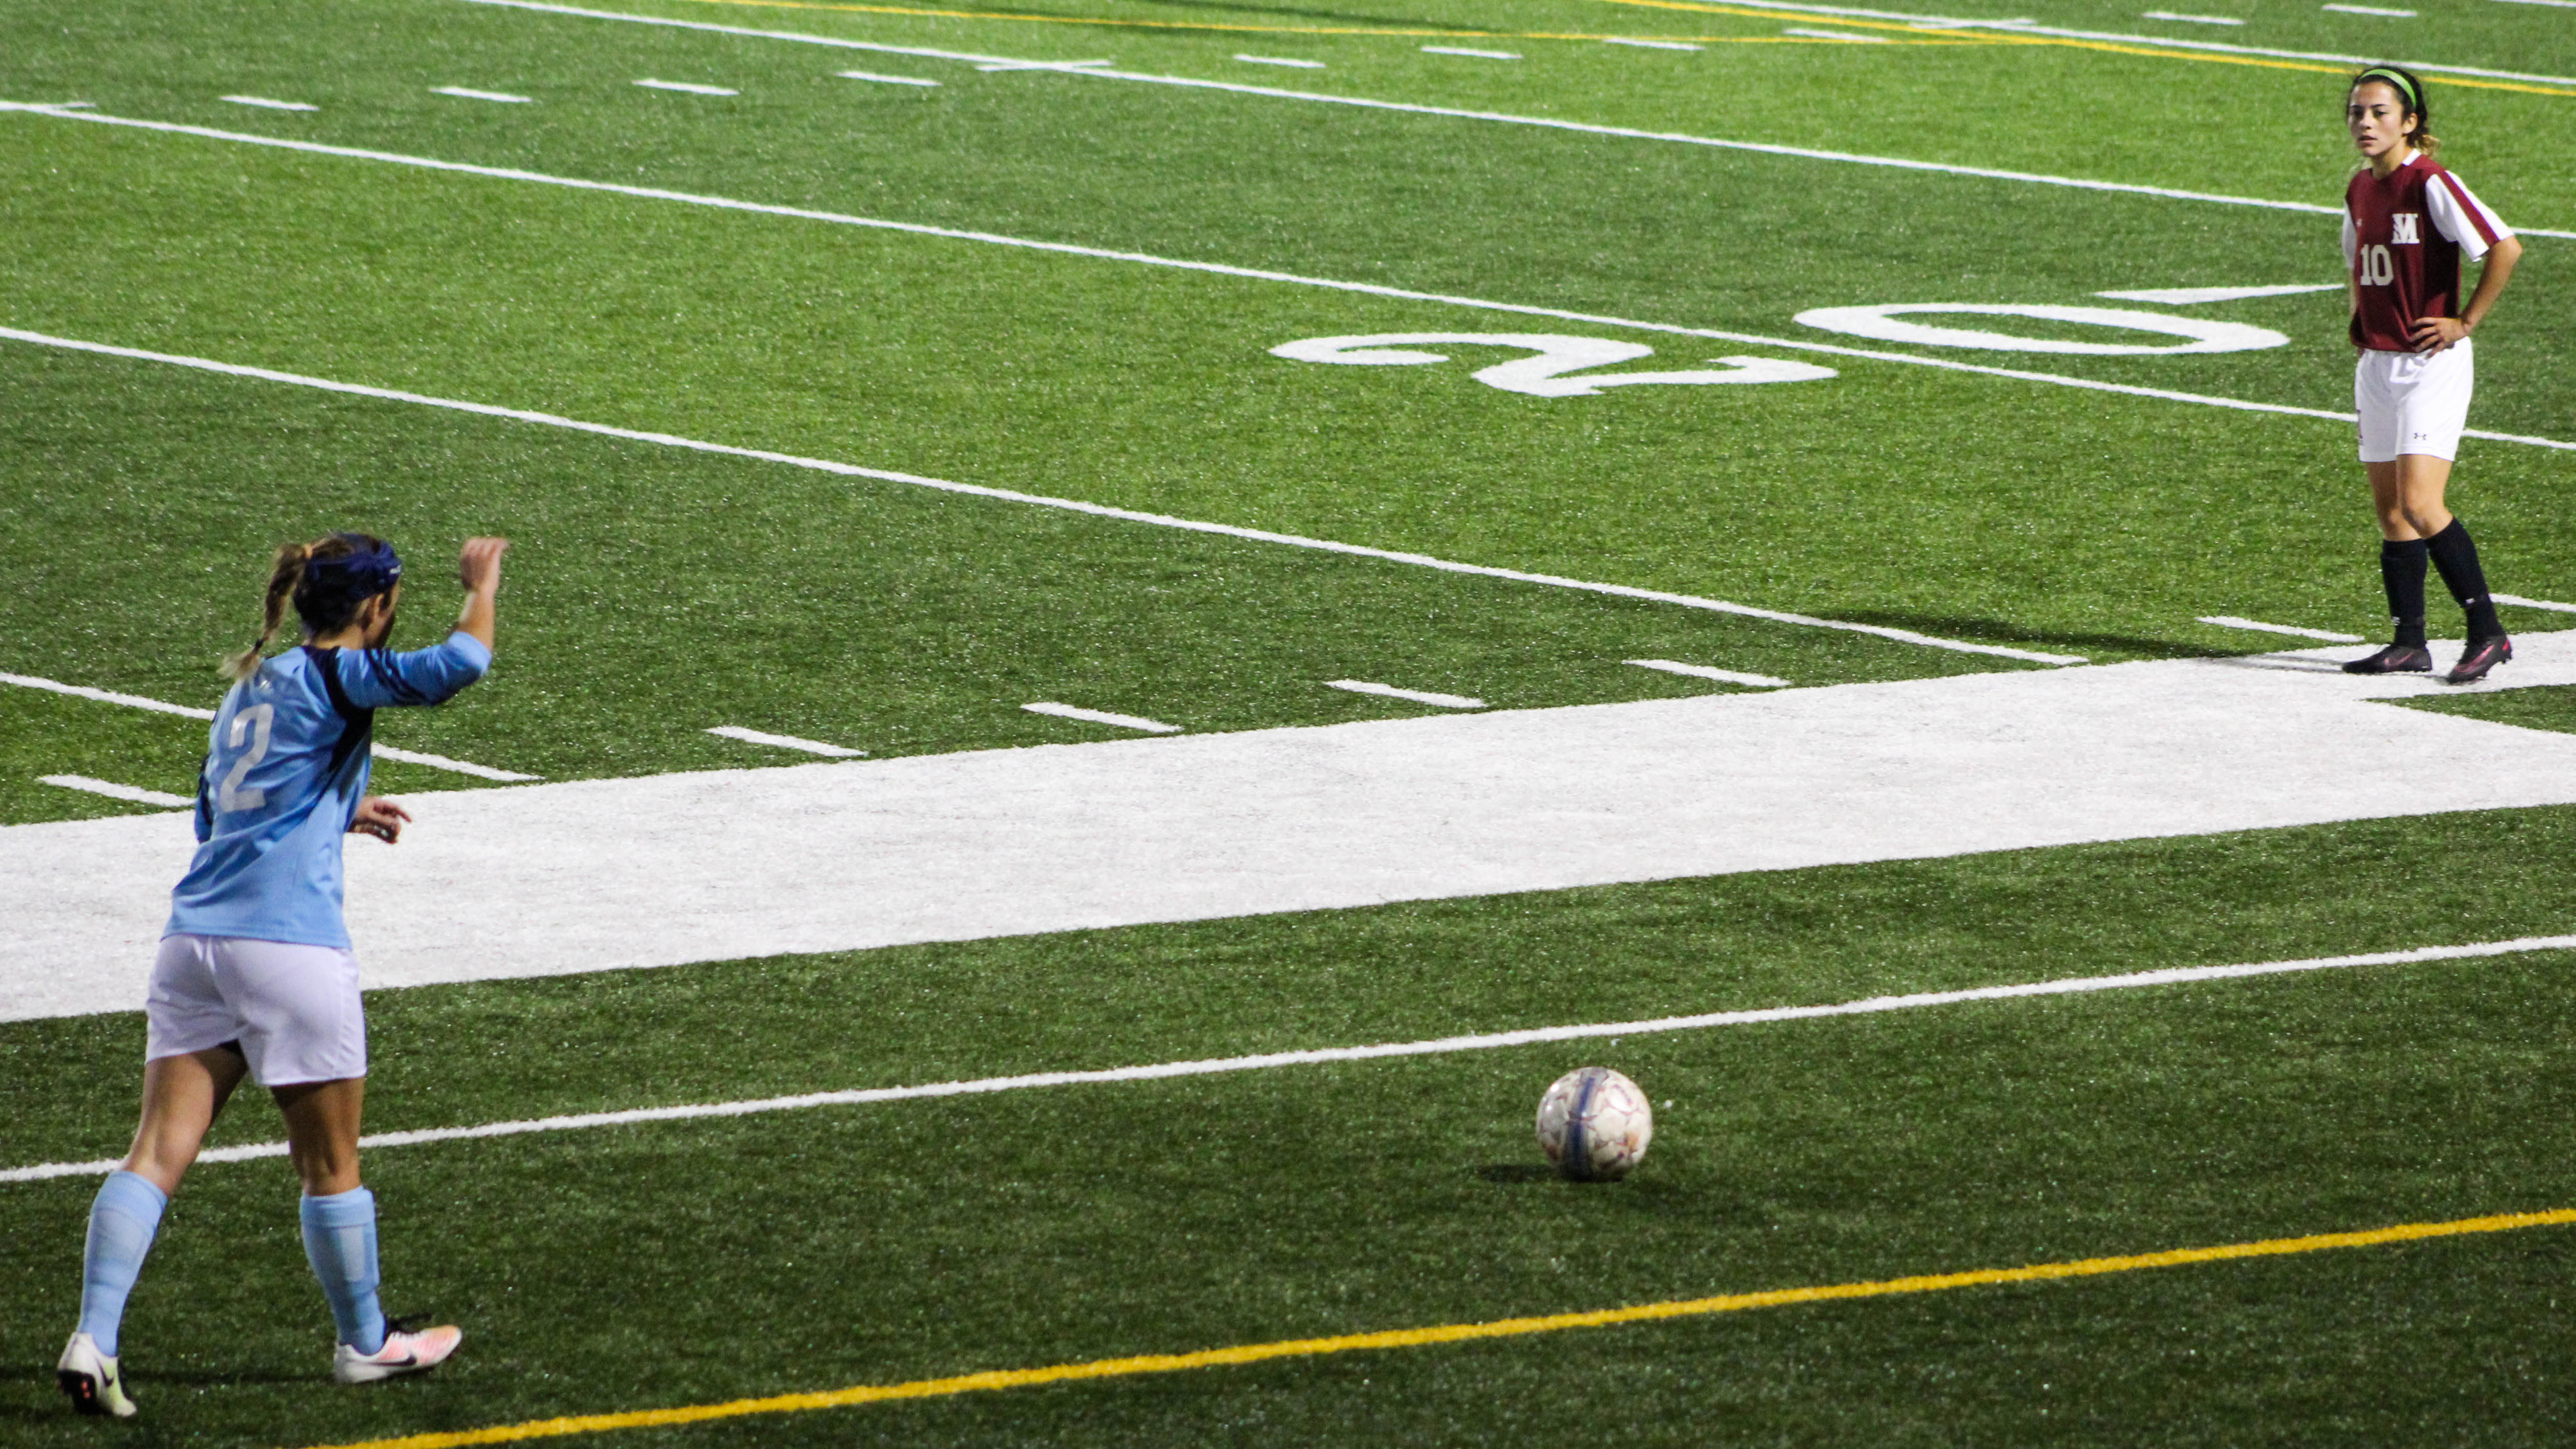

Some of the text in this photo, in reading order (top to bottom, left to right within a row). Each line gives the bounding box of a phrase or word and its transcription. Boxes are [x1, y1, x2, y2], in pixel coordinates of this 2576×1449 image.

[2360, 244, 2394, 286] 10
[1268, 303, 2291, 397] 20
[220, 703, 274, 812] 2
